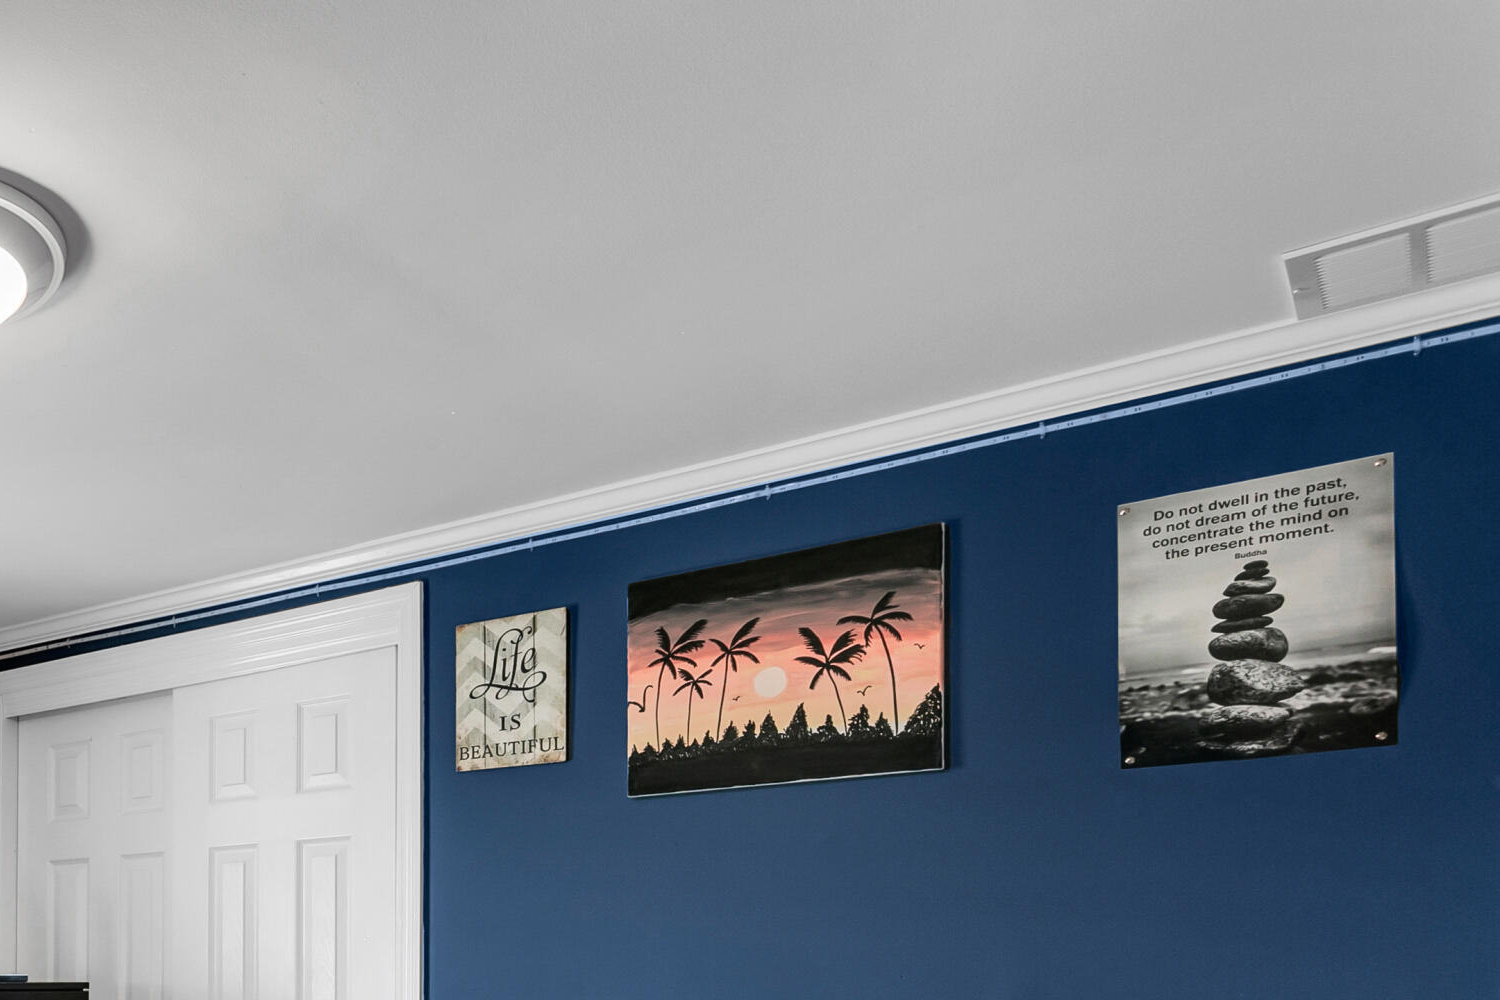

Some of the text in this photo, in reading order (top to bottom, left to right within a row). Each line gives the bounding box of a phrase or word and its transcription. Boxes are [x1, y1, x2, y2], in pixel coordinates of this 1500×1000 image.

[1143, 525, 1161, 537] do
[1166, 519, 1190, 533] not
[1195, 511, 1246, 527] dream
[1251, 505, 1268, 518] of
[1272, 499, 1299, 514] the
[1153, 477, 1347, 522] Do not dwell in the past,
[1152, 507, 1349, 549] concentrate the mind on
[1165, 524, 1334, 560] the present moment.
[1234, 549, 1268, 560] Buddha
[469, 625, 547, 703] Life
[500, 713, 521, 732] IS
[459, 736, 565, 761] BEAUTIFUL
